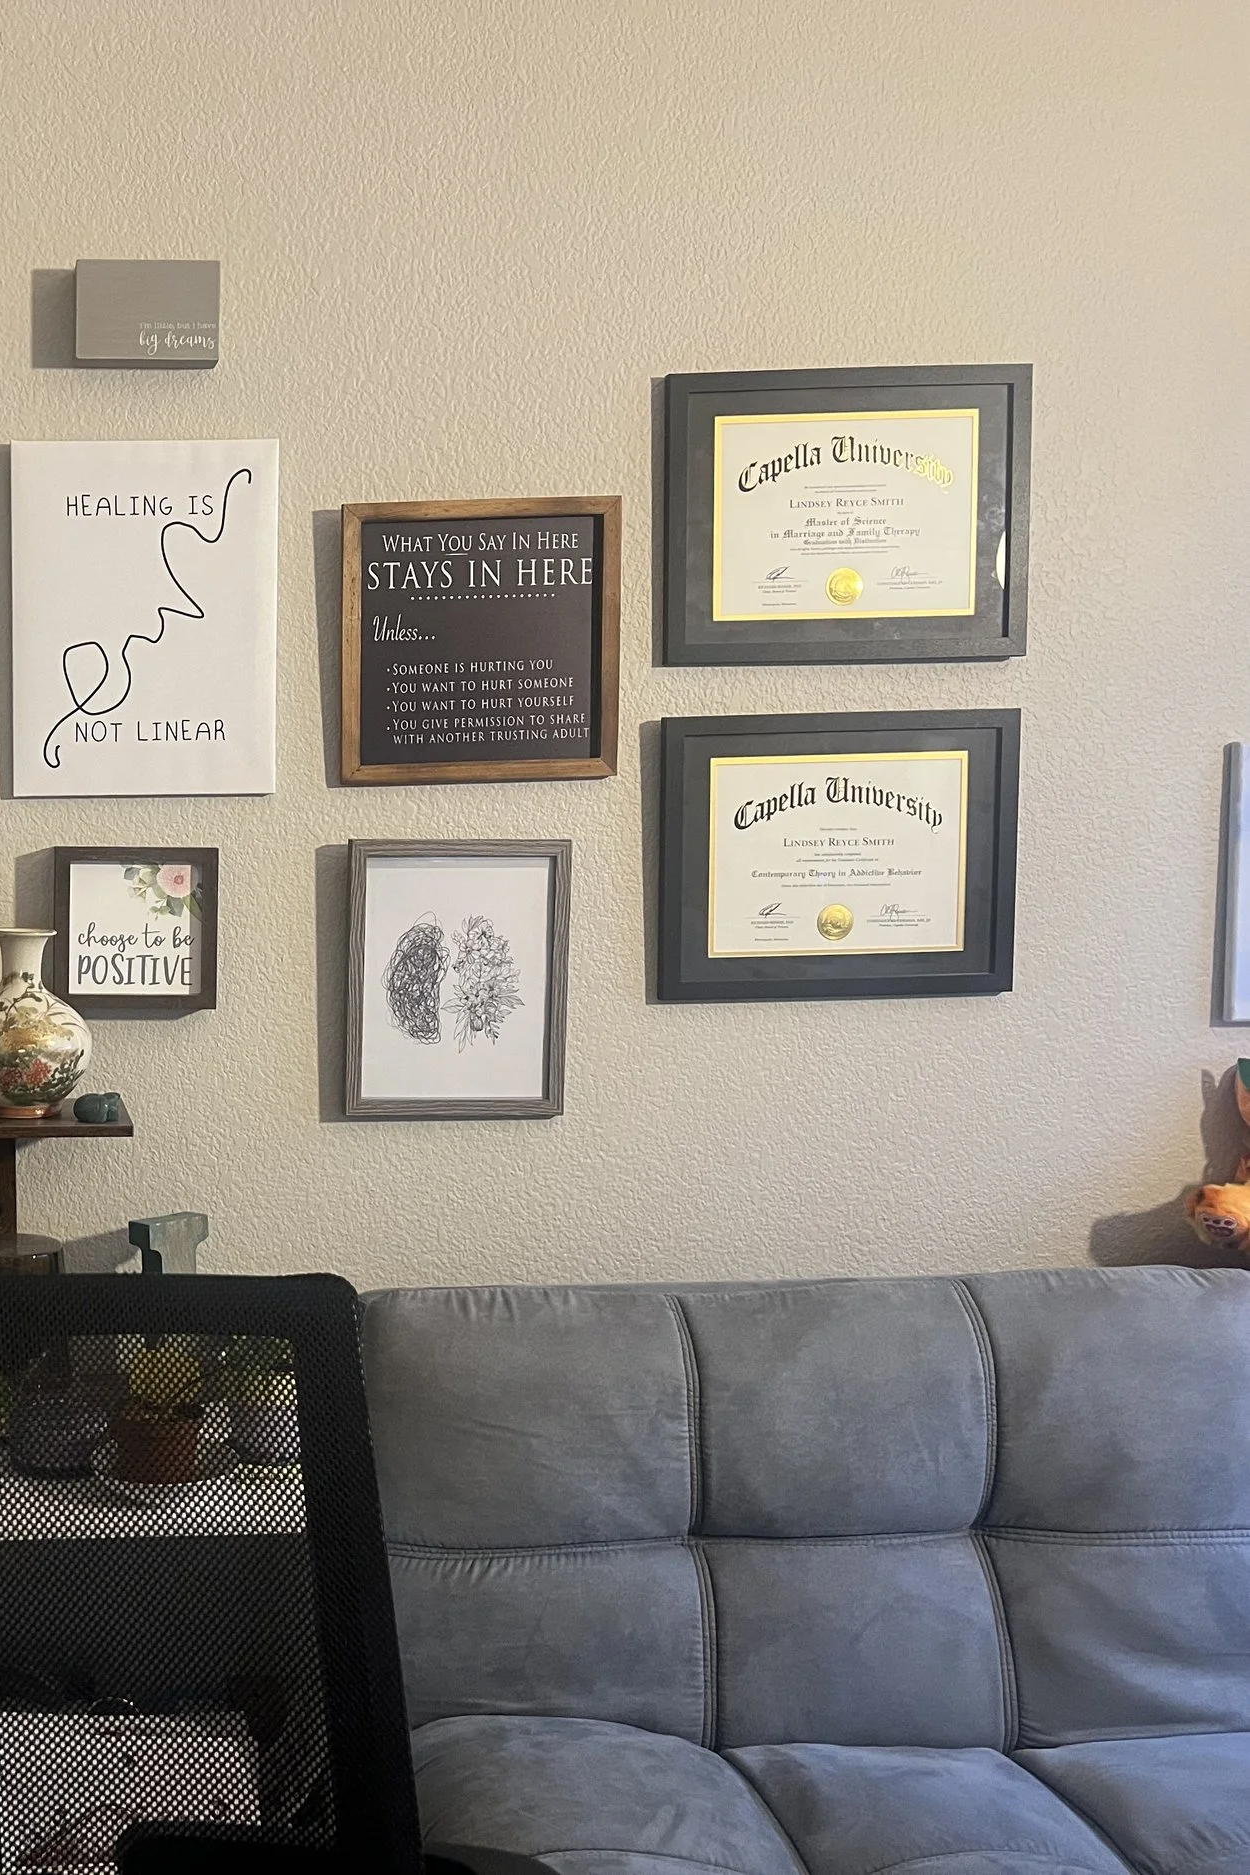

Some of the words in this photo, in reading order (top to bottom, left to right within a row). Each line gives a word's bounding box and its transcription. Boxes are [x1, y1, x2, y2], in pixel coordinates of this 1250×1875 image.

[177, 321, 190, 329] but
[198, 321, 216, 329] have
[139, 330, 161, 356] big
[164, 330, 216, 350] dreams
[738, 443, 822, 493] Capella
[831, 436, 954, 493] University
[66, 494, 173, 516] HEALING
[188, 495, 214, 516] IS
[790, 498, 832, 509] LINDSEY
[870, 496, 904, 506] SMITH
[804, 518, 838, 527] Master
[840, 517, 850, 526] of
[853, 516, 887, 525] Science
[770, 530, 780, 539] in
[782, 529, 826, 540] Marriage
[827, 529, 844, 538] and
[846, 528, 880, 538] Family
[883, 526, 920, 538] Therapy
[382, 534, 433, 552] WHAT
[438, 534, 472, 552] YOU
[478, 532, 506, 550] SAY
[512, 532, 530, 549] IN
[538, 532, 578, 549] HERE
[367, 561, 453, 590] STAYS
[468, 560, 502, 588] IN
[517, 558, 593, 586] HERE
[372, 614, 436, 642] Unless...
[393, 662, 449, 676] SOMEONE
[454, 662, 465, 674] IS
[470, 660, 524, 672] HURTING
[529, 660, 554, 670] YOU
[392, 682, 417, 694] YOU
[422, 682, 455, 693] WANT
[460, 680, 476, 692] TO
[481, 680, 512, 690] HURT
[518, 678, 574, 690] SOMEONE
[392, 700, 417, 712] YOU
[422, 700, 455, 712] WANT
[460, 700, 476, 710] TO
[481, 698, 512, 709] HURT
[518, 696, 575, 708] YOURSELF
[393, 719, 417, 730] YOU
[422, 718, 449, 730] GIVE
[454, 716, 525, 728] PERMISSION
[530, 715, 545, 726] TO
[550, 713, 586, 724] SHARE
[74, 720, 123, 743] NOT
[137, 720, 226, 742] LINEAR
[393, 734, 424, 744] WITH
[429, 732, 484, 744] ANOTHER
[490, 729, 548, 742] TRUSTING
[552, 728, 590, 739] ADULT
[734, 781, 816, 830] Capella
[826, 776, 943, 834] University
[783, 838, 826, 848] LINDSEY
[862, 836, 895, 846] SMITH
[752, 870, 806, 879] Contemporary
[808, 869, 836, 878] Theory
[838, 869, 846, 877] in
[849, 869, 885, 878] Addictive
[887, 868, 922, 877] Behavior
[78, 922, 138, 952] choose
[142, 923, 166, 948] to
[173, 926, 195, 948] be
[77, 953, 193, 986] POSITIVE
